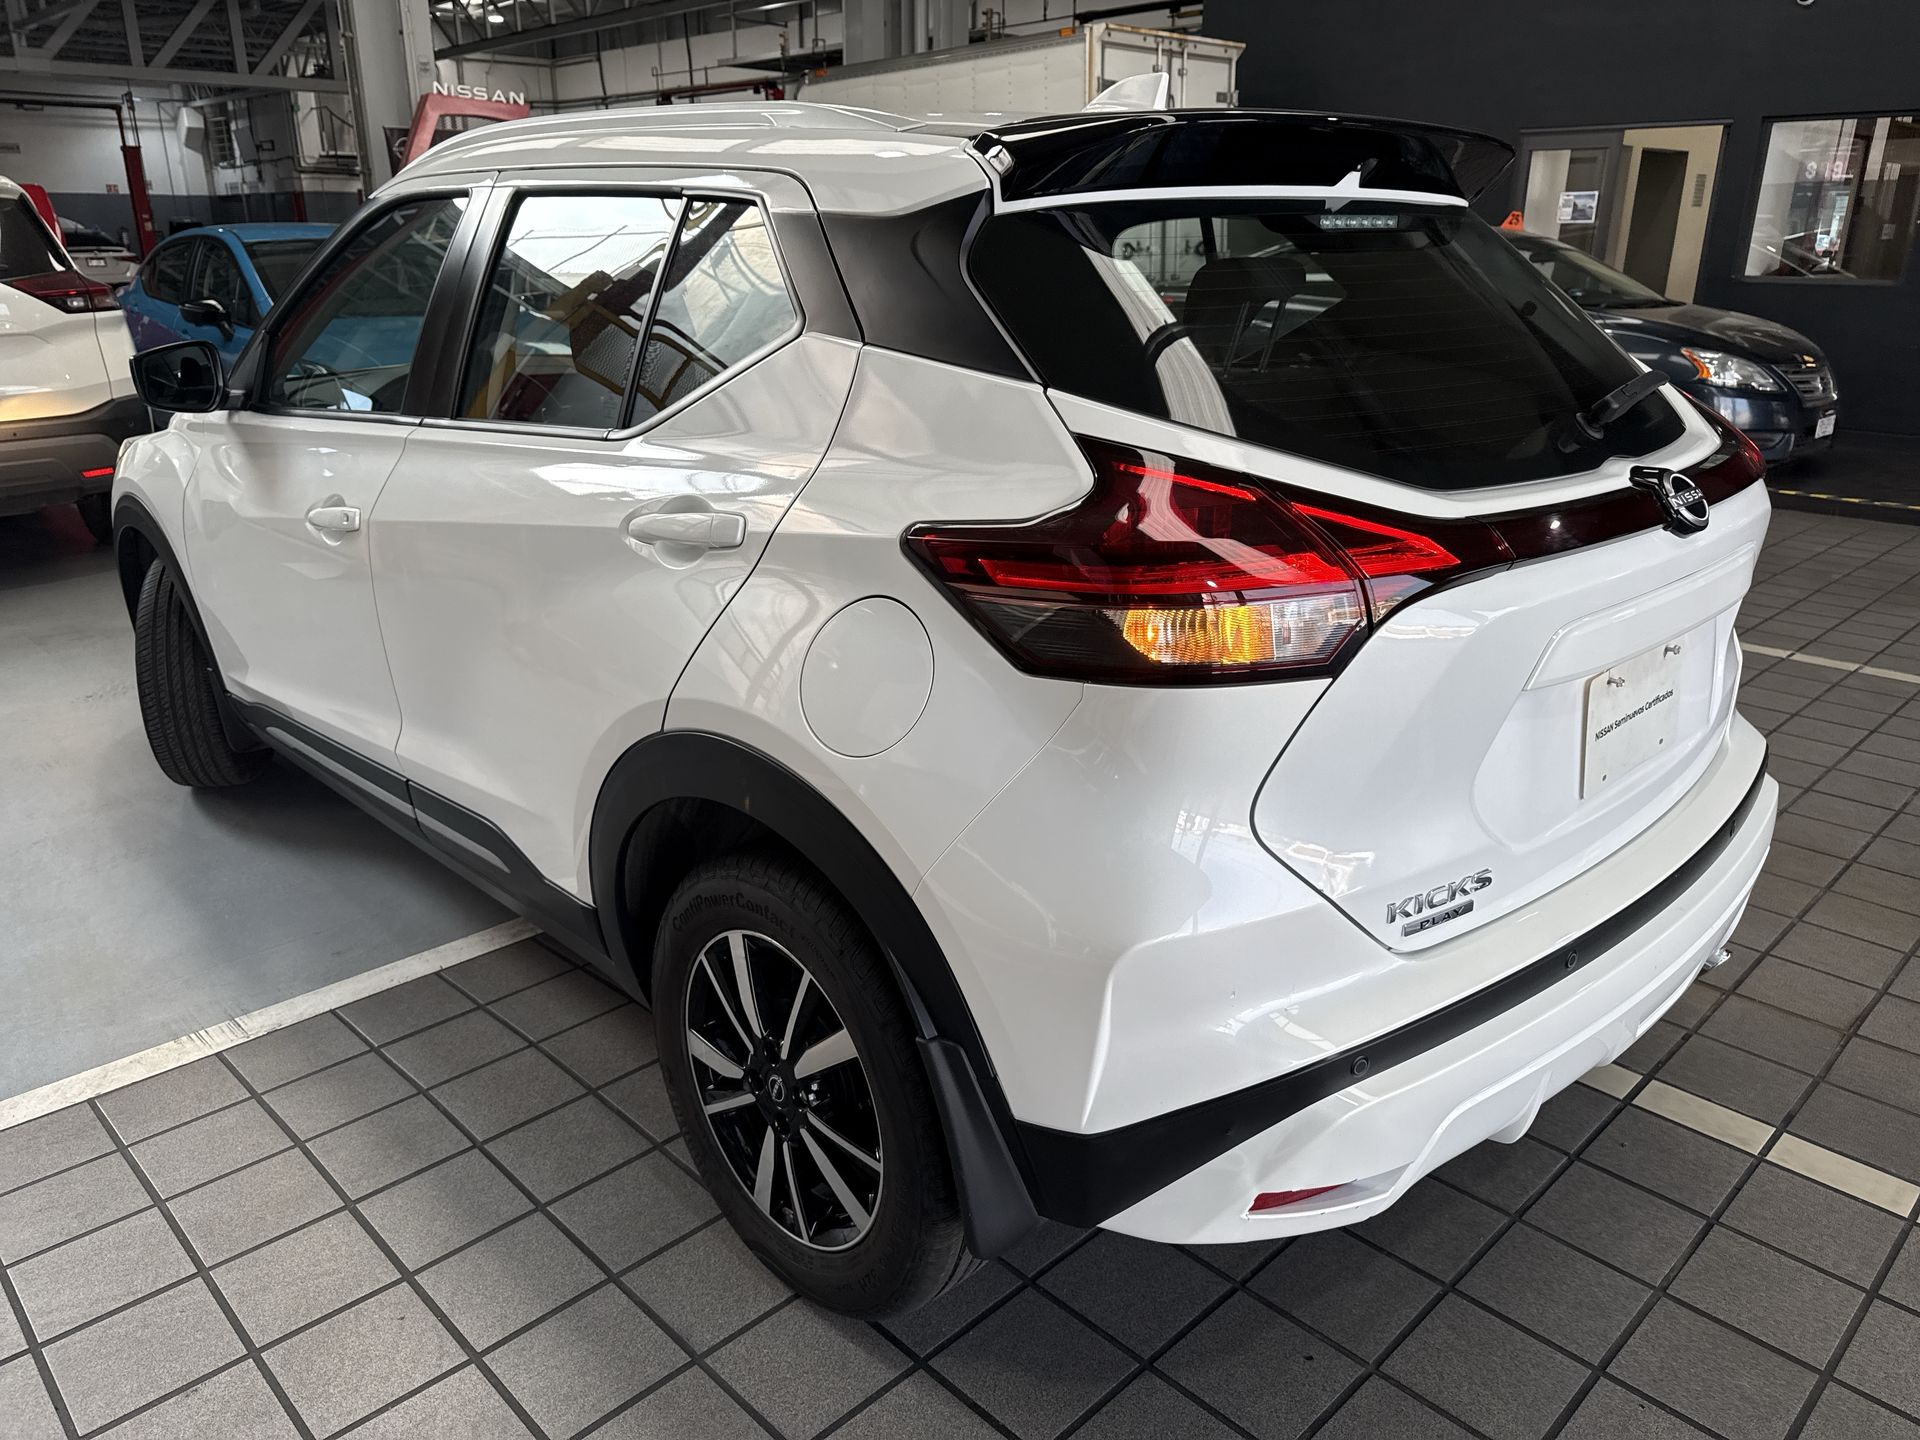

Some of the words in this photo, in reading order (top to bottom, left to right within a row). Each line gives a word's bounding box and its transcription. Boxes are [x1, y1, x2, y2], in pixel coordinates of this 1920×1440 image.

[432, 80, 525, 106] NISSAN
[1594, 723, 1614, 742] NISSAN
[1614, 706, 1645, 730] Seminuevos
[1645, 689, 1674, 711] Certificados
[1386, 868, 1492, 924] KICKS
[1420, 905, 1464, 930] PLAY
